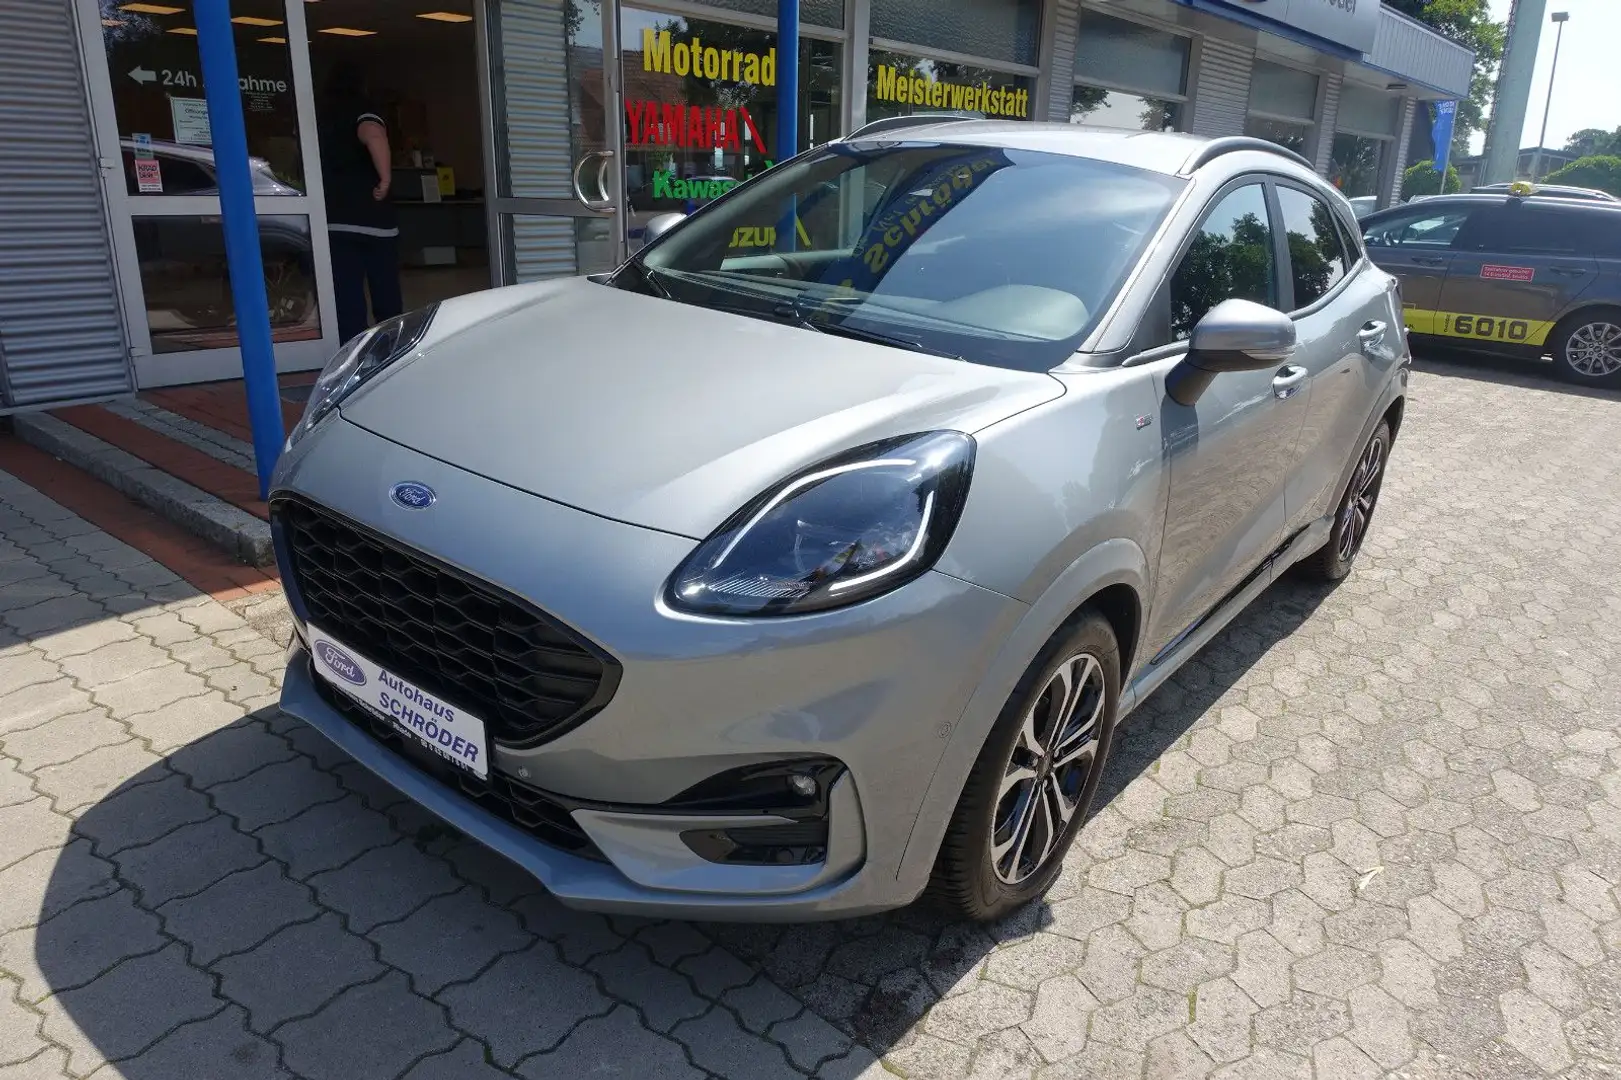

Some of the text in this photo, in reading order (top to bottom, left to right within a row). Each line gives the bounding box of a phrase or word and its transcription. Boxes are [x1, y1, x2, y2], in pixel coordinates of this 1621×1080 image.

[643, 27, 776, 86] Motorrad
[161, 69, 197, 88] 24h
[876, 64, 1029, 118] Meisterwerkstatt
[624, 98, 741, 149] YAMAHA
[652, 170, 738, 199] Kawas
[1454, 315, 1528, 340] 6010
[399, 487, 426, 505] Ford
[324, 646, 356, 679] Ford
[378, 669, 455, 723] Autohaus
[379, 691, 479, 763] SCHRÖDER
